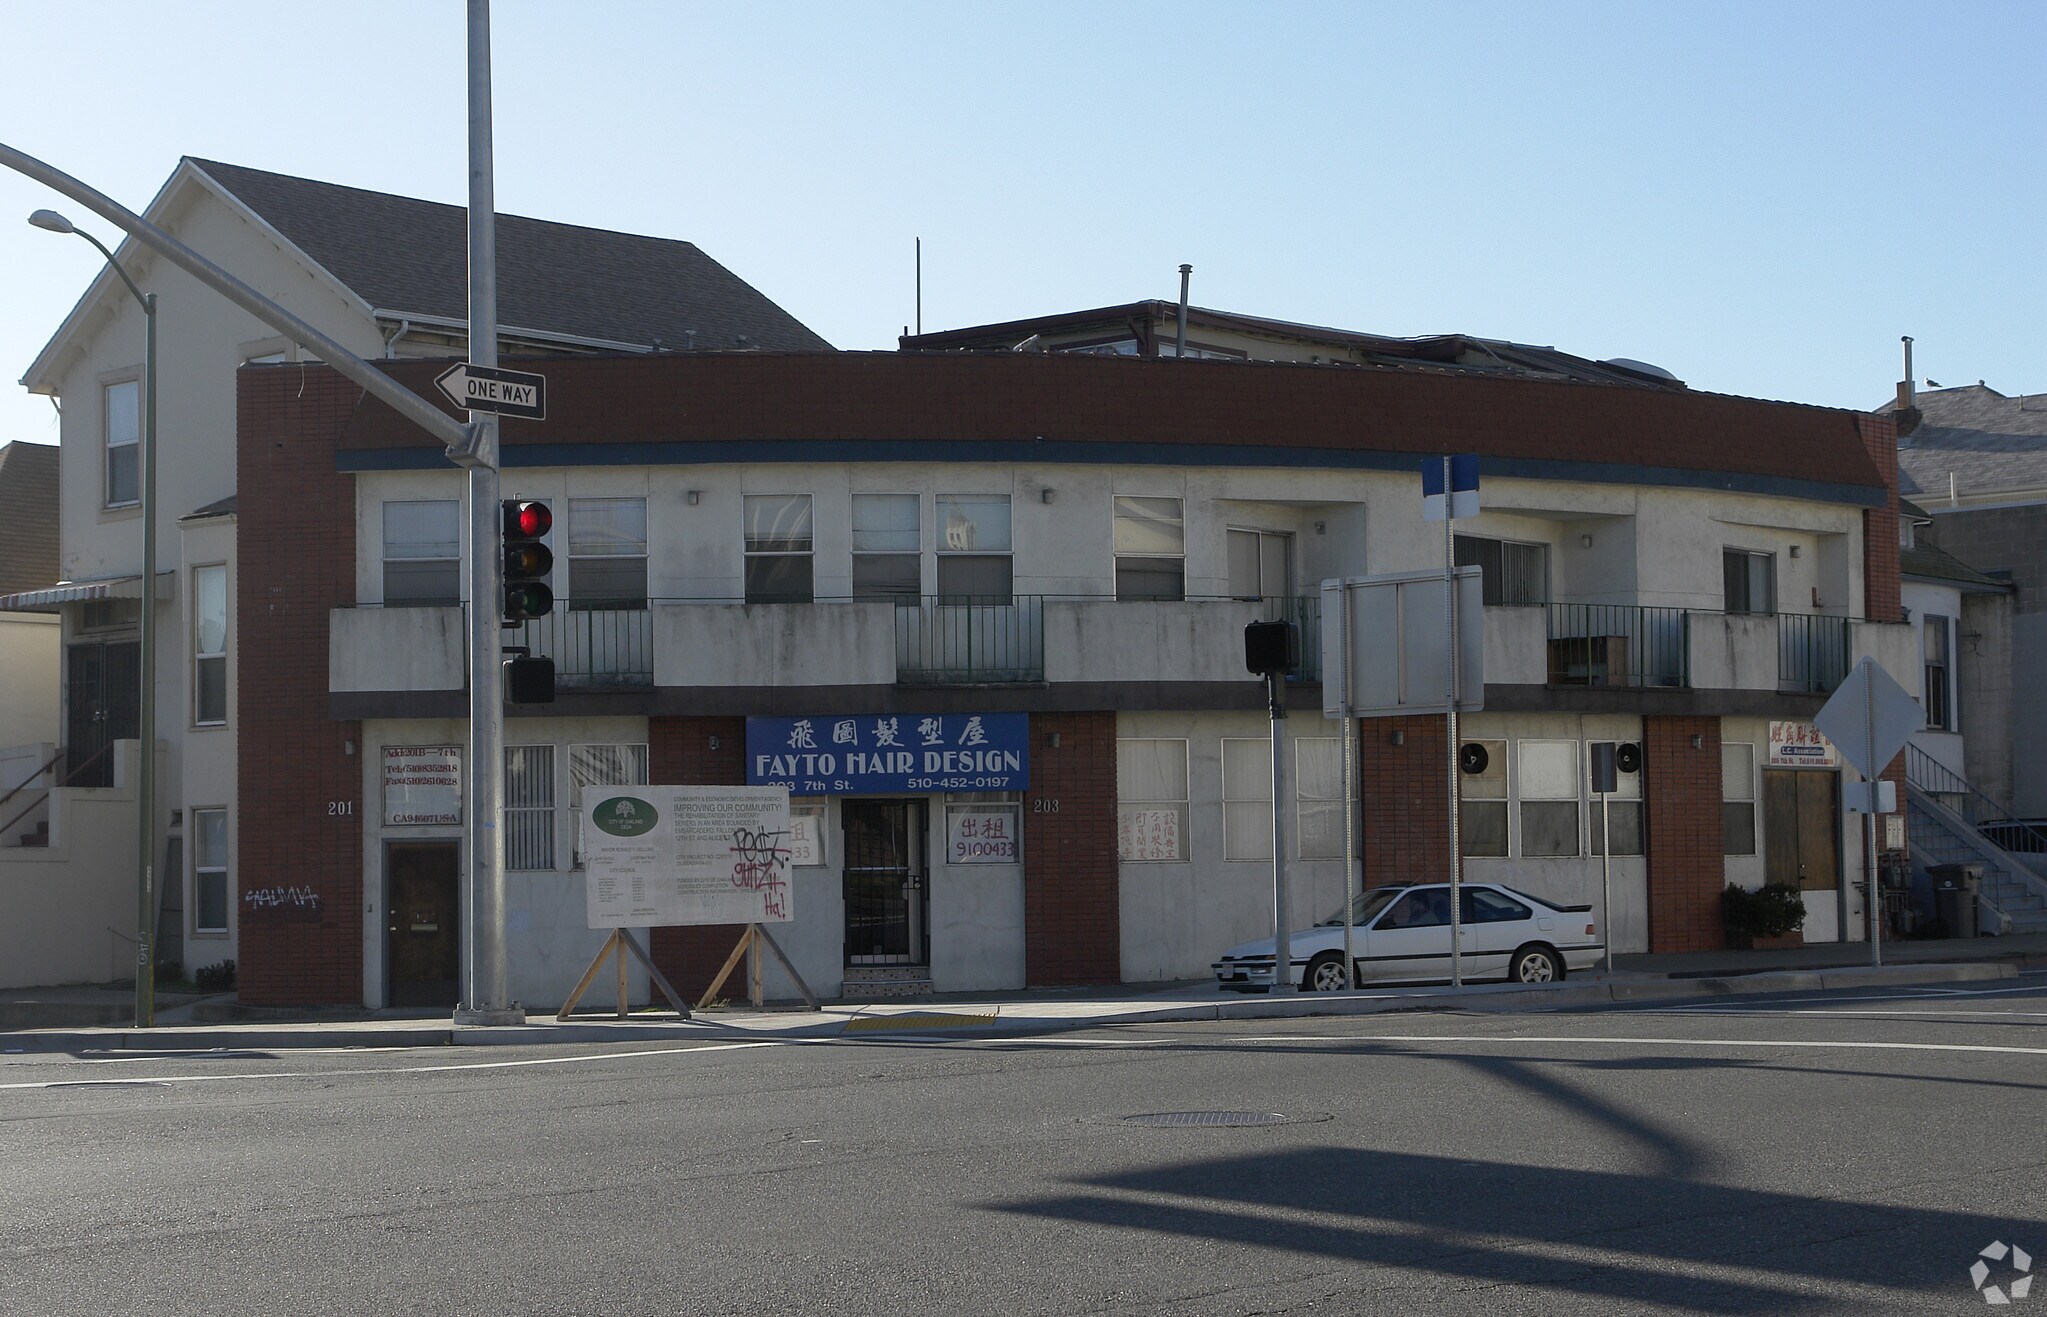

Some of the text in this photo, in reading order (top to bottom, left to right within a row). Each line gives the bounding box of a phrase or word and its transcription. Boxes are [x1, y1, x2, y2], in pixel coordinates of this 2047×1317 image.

[468, 380, 532, 403] ONE WAY
[786, 715, 989, 749] 飛圖髮型屋
[1794, 747, 1824, 755] Association
[756, 749, 1020, 777] FAYTO HAIR DESIGN
[804, 780, 826, 791] 7th
[834, 780, 854, 790] St.
[907, 777, 1010, 788] 510-452-0197
[328, 801, 353, 815] 201
[673, 804, 782, 812] IMPROVING OUR COMMUNITY!
[1034, 800, 1059, 813] 203
[962, 817, 1009, 839] 出租
[956, 842, 1015, 857] 9100433
